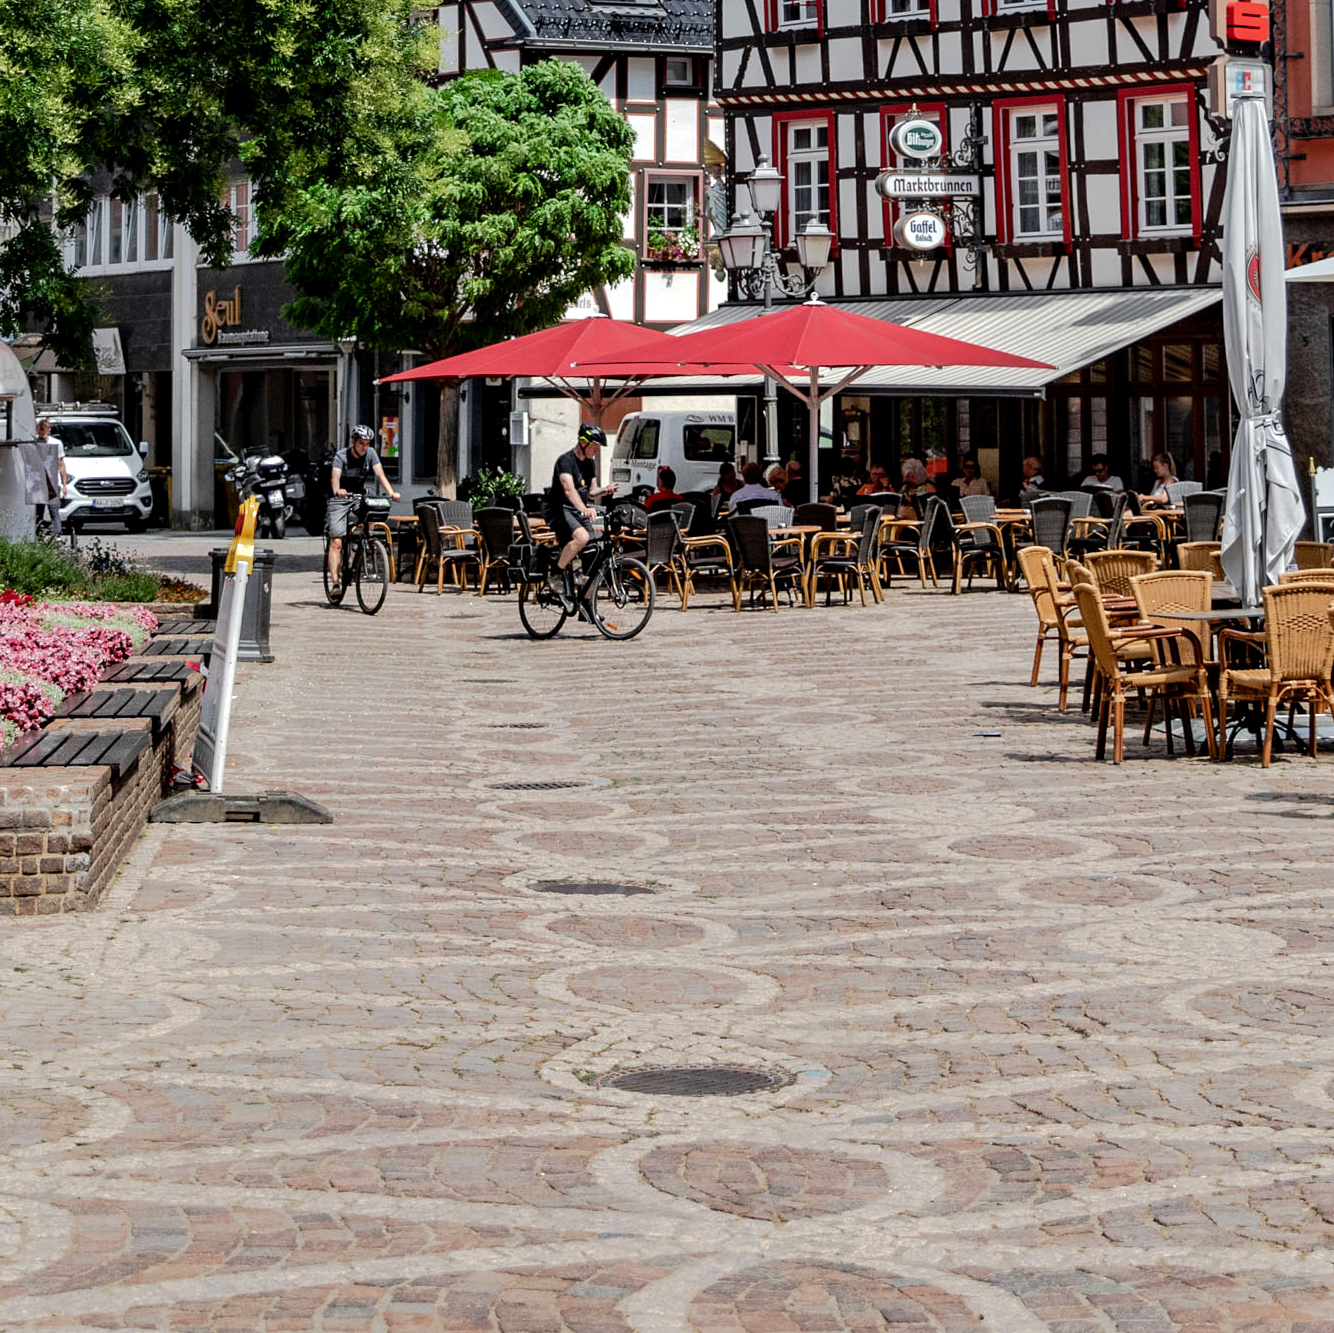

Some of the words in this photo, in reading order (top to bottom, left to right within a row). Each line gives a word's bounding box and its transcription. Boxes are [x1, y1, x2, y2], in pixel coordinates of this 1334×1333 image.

[893, 177, 973, 193] Marktbrunnen
[910, 219, 937, 235] Gaffel
[631, 460, 657, 471] Montage
